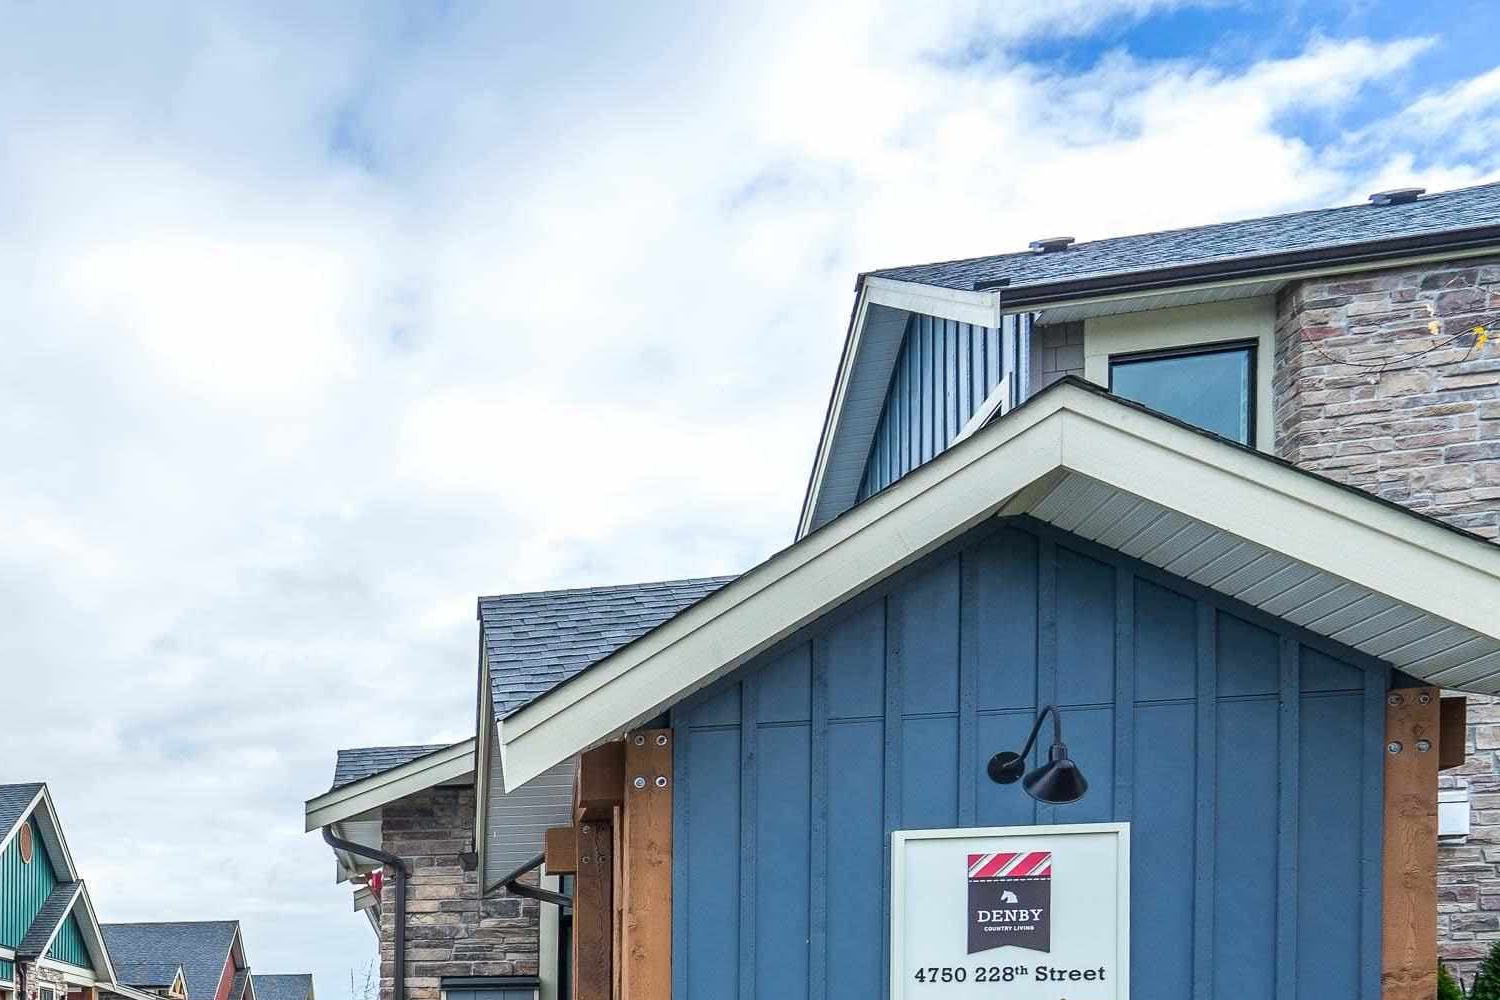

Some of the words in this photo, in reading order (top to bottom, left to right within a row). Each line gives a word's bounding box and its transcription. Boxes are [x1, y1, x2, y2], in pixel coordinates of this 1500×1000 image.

[977, 908, 1043, 922] DENBY
[914, 967, 967, 983] 4750
[975, 965, 1029, 982] 228th
[1035, 966, 1106, 981] Street
